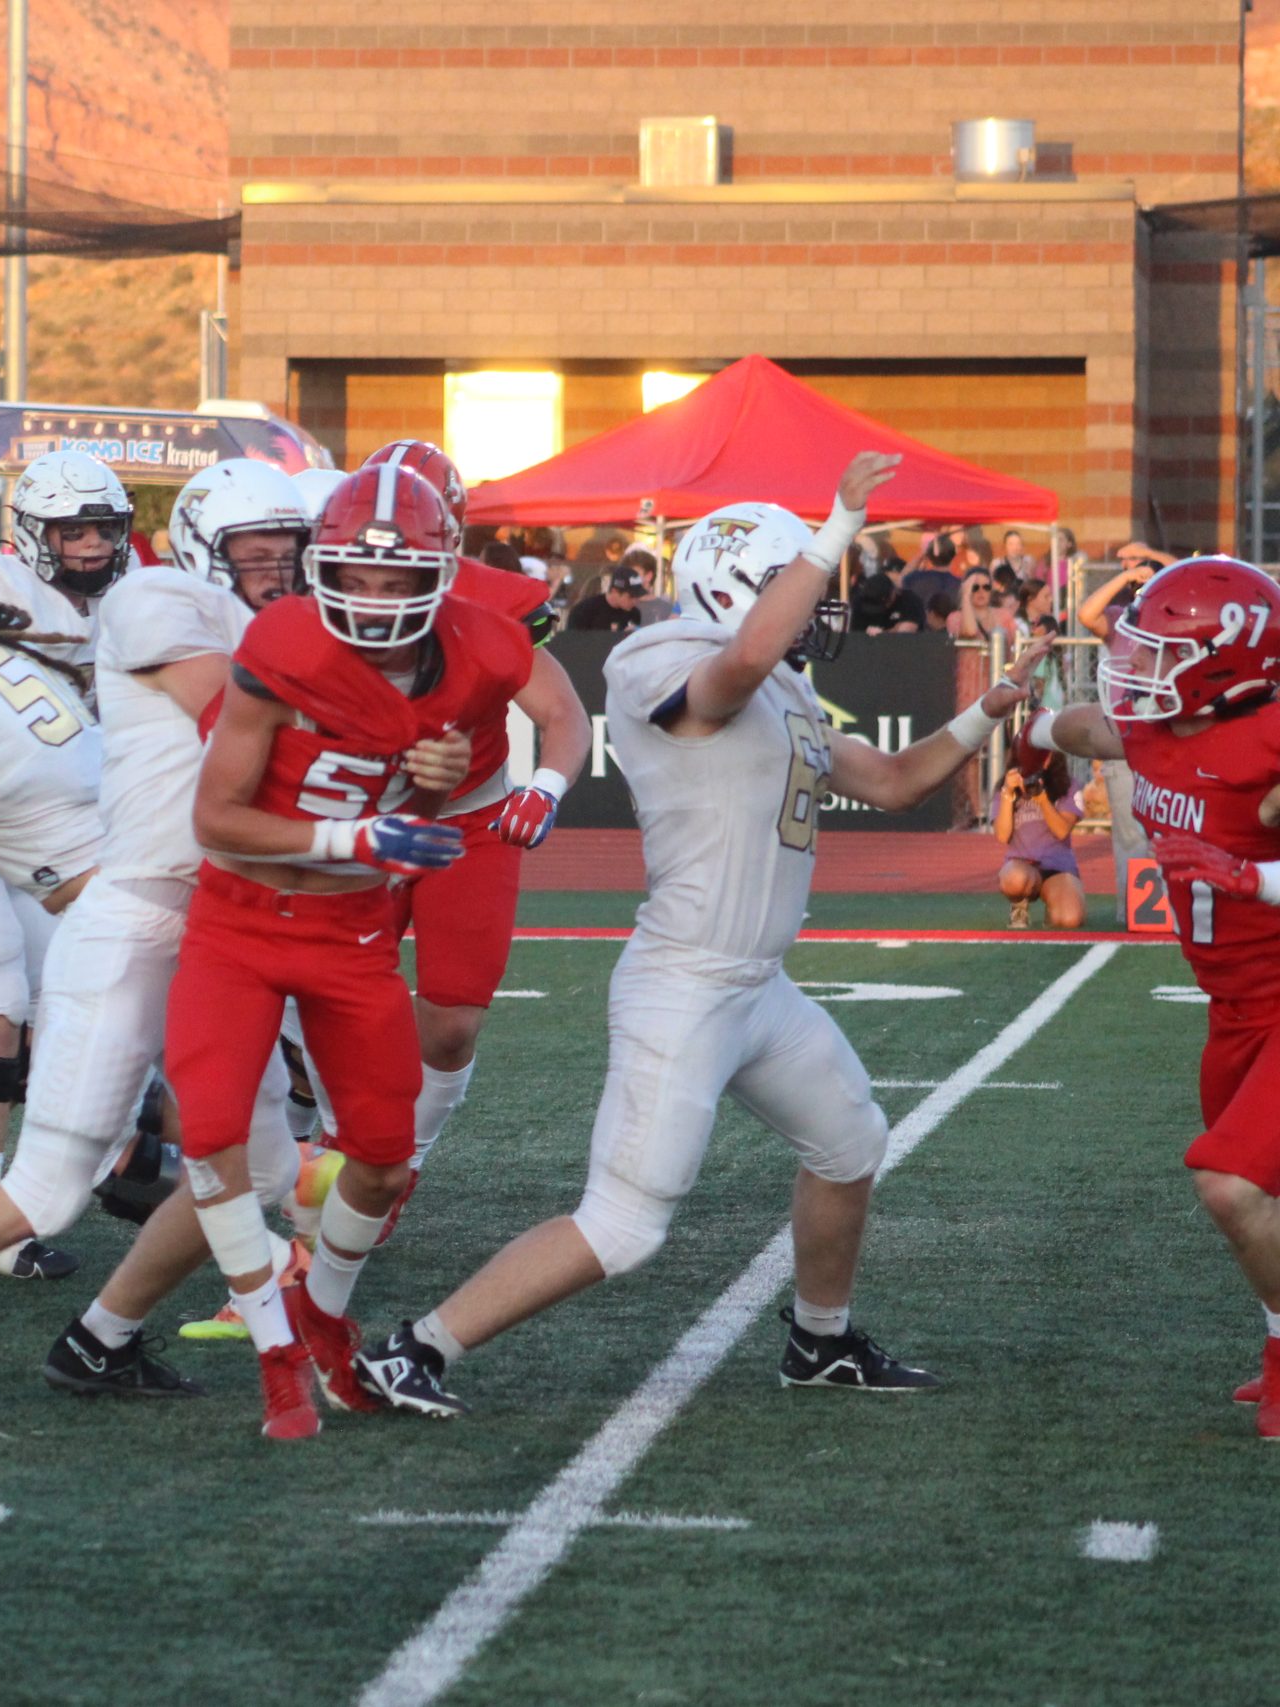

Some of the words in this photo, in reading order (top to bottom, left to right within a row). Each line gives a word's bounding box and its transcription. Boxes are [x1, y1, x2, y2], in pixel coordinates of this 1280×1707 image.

[126, 440, 164, 463] ICE
[167, 442, 218, 470] krafted
[1220, 602, 1270, 648] 97
